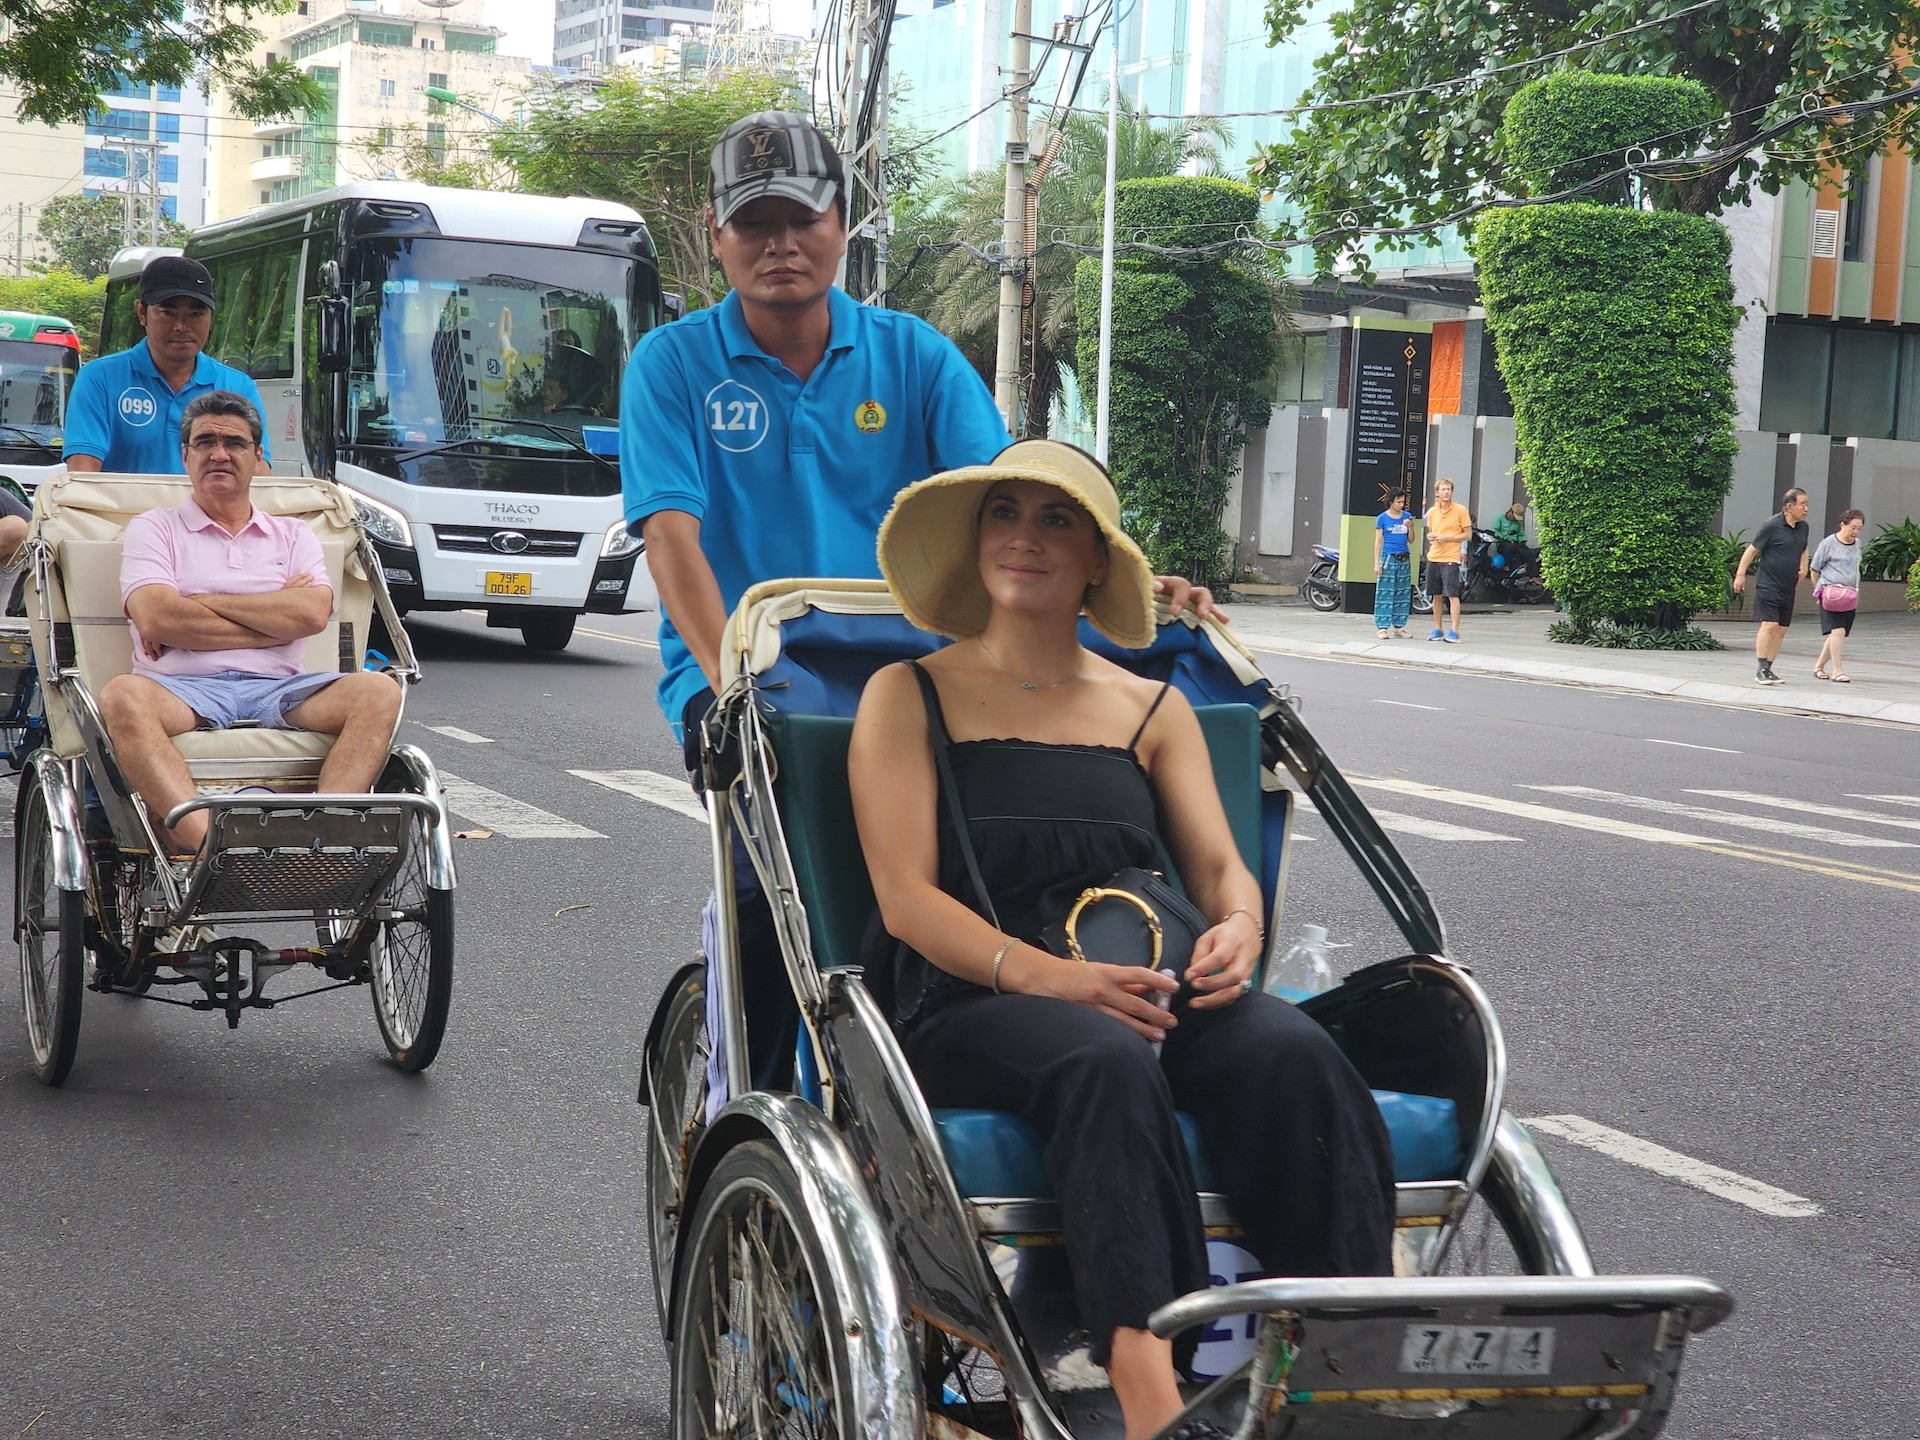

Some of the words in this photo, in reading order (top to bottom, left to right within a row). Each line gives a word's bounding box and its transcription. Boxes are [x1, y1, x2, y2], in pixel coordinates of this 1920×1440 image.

[122, 397, 153, 415] 099
[711, 400, 759, 430] 127
[484, 502, 540, 515] THACO
[491, 516, 533, 524] BLUESKY
[500, 573, 519, 583] 79F
[491, 584, 526, 595] 001.26
